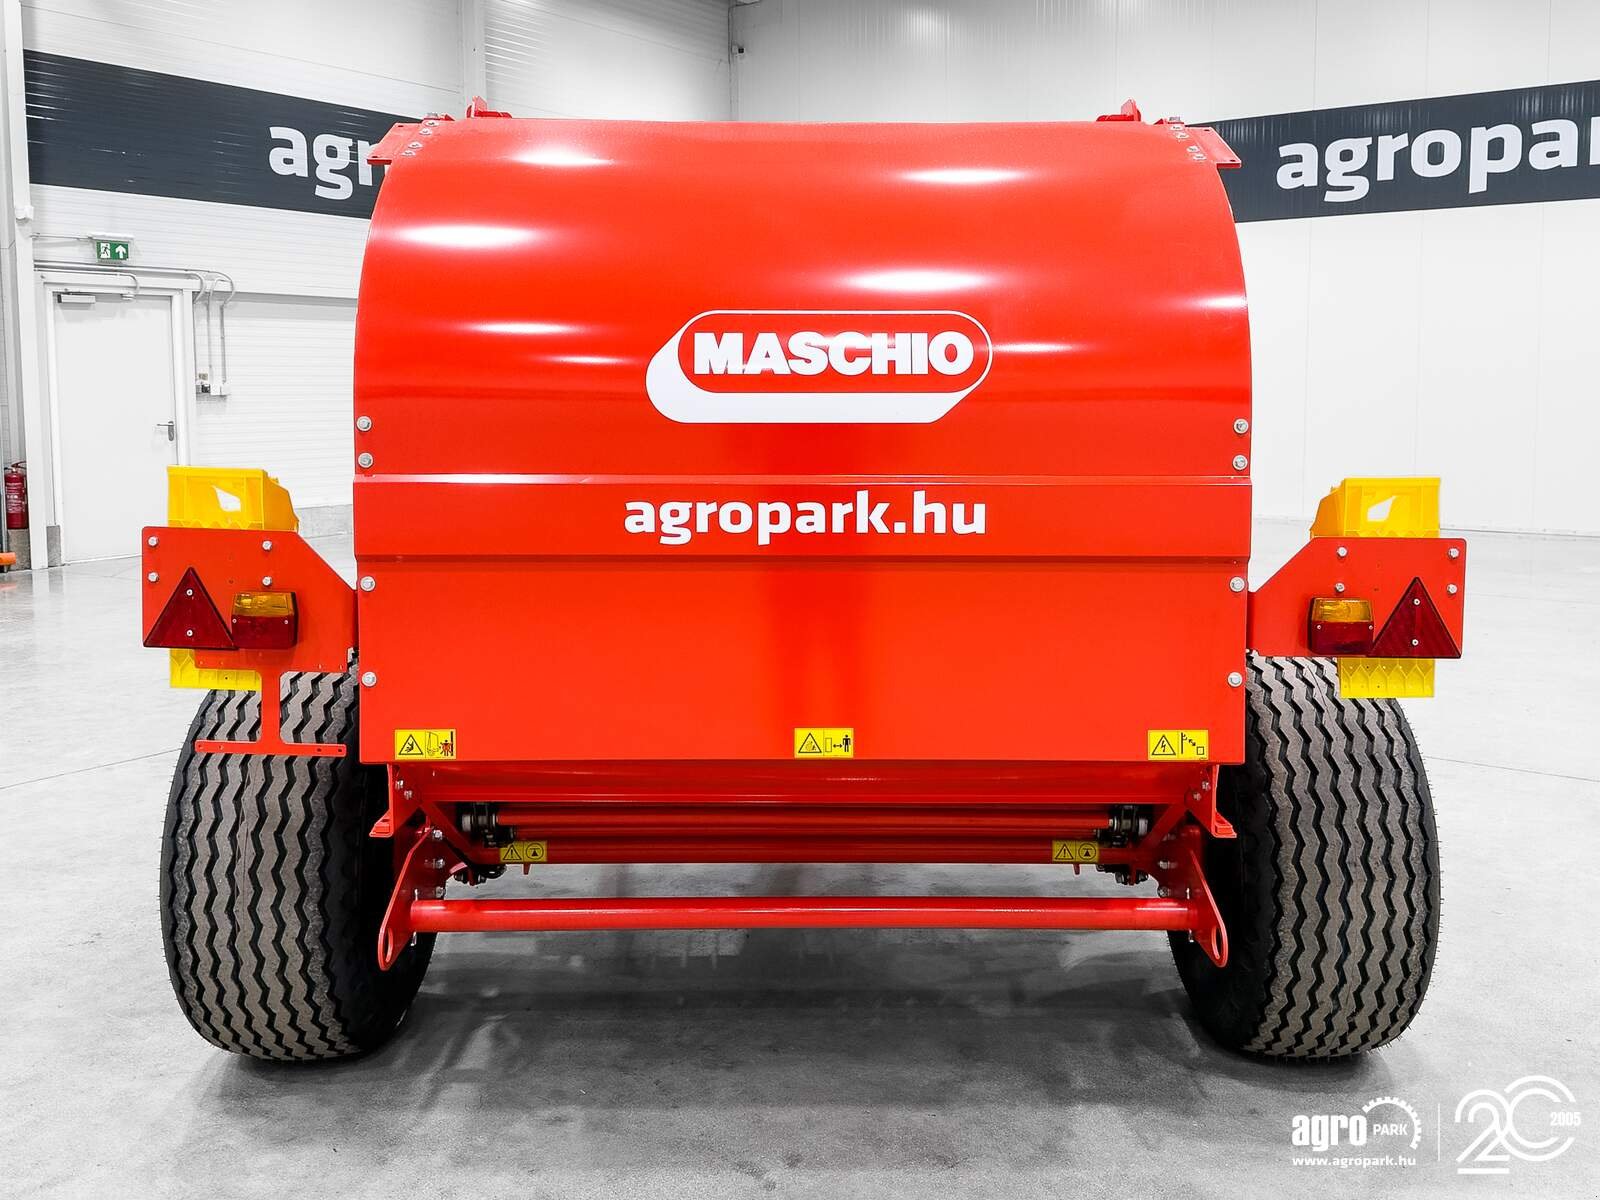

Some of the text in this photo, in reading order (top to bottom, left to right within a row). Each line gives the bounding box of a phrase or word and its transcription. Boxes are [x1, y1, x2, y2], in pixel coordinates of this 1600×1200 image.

[269, 126, 391, 200] agr
[693, 331, 975, 376] MASCHIO
[624, 490, 986, 546] agropark.hu
